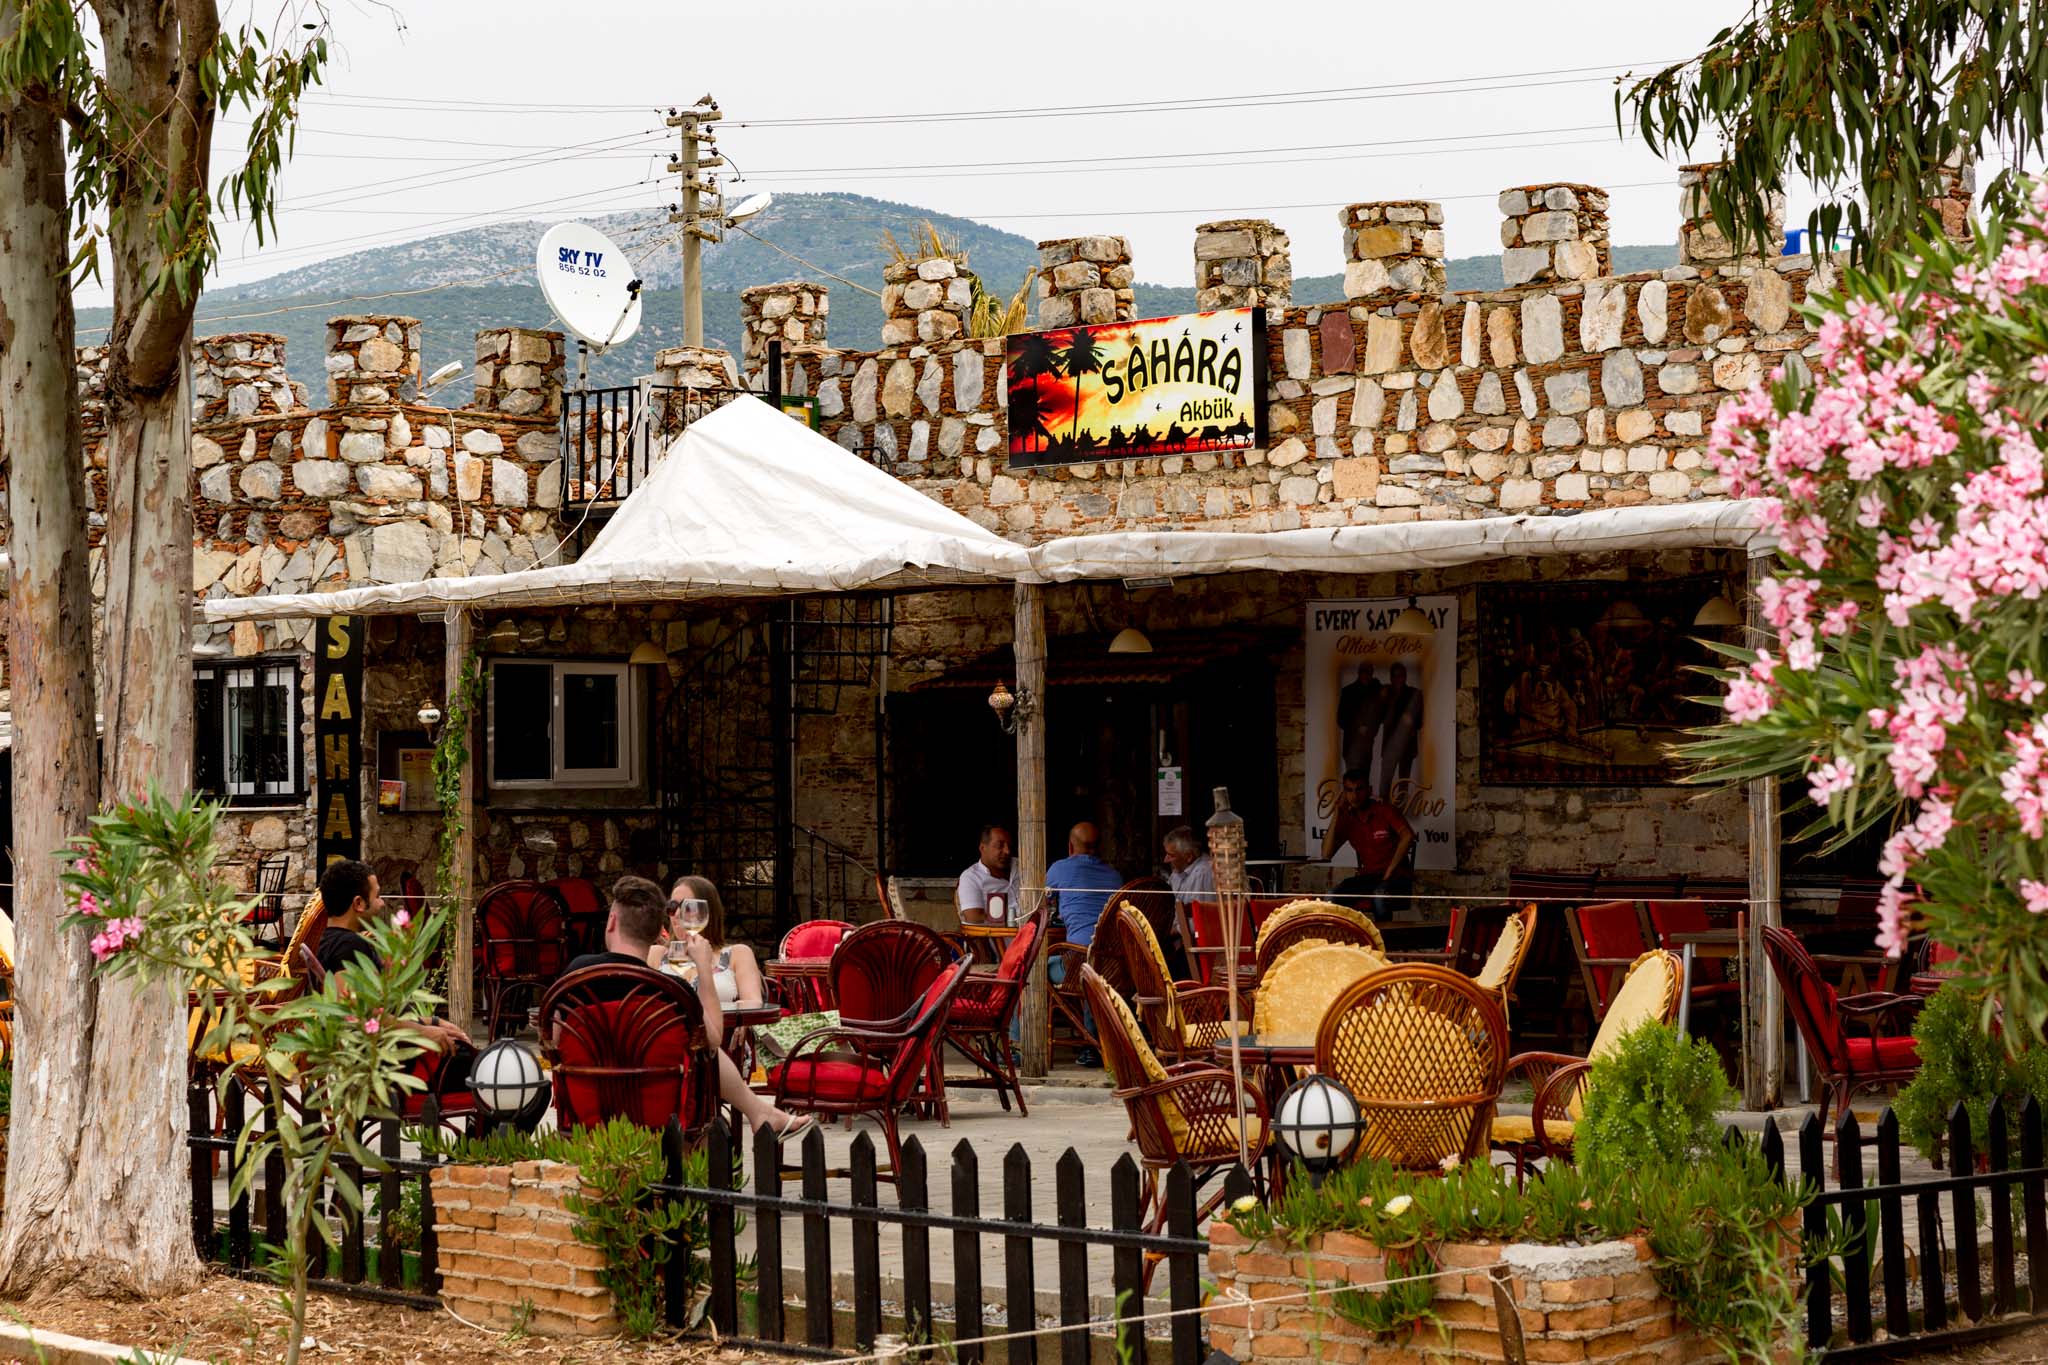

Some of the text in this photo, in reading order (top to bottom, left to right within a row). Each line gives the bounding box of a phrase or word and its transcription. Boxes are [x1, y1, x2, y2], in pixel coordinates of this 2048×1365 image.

[558, 246, 603, 268] SKY TV
[559, 263, 607, 278] 856 52 02
[1102, 336, 1242, 405] SAHARA
[1180, 397, 1234, 422] Akbük
[1315, 607, 1449, 632] EVERY SATAY
